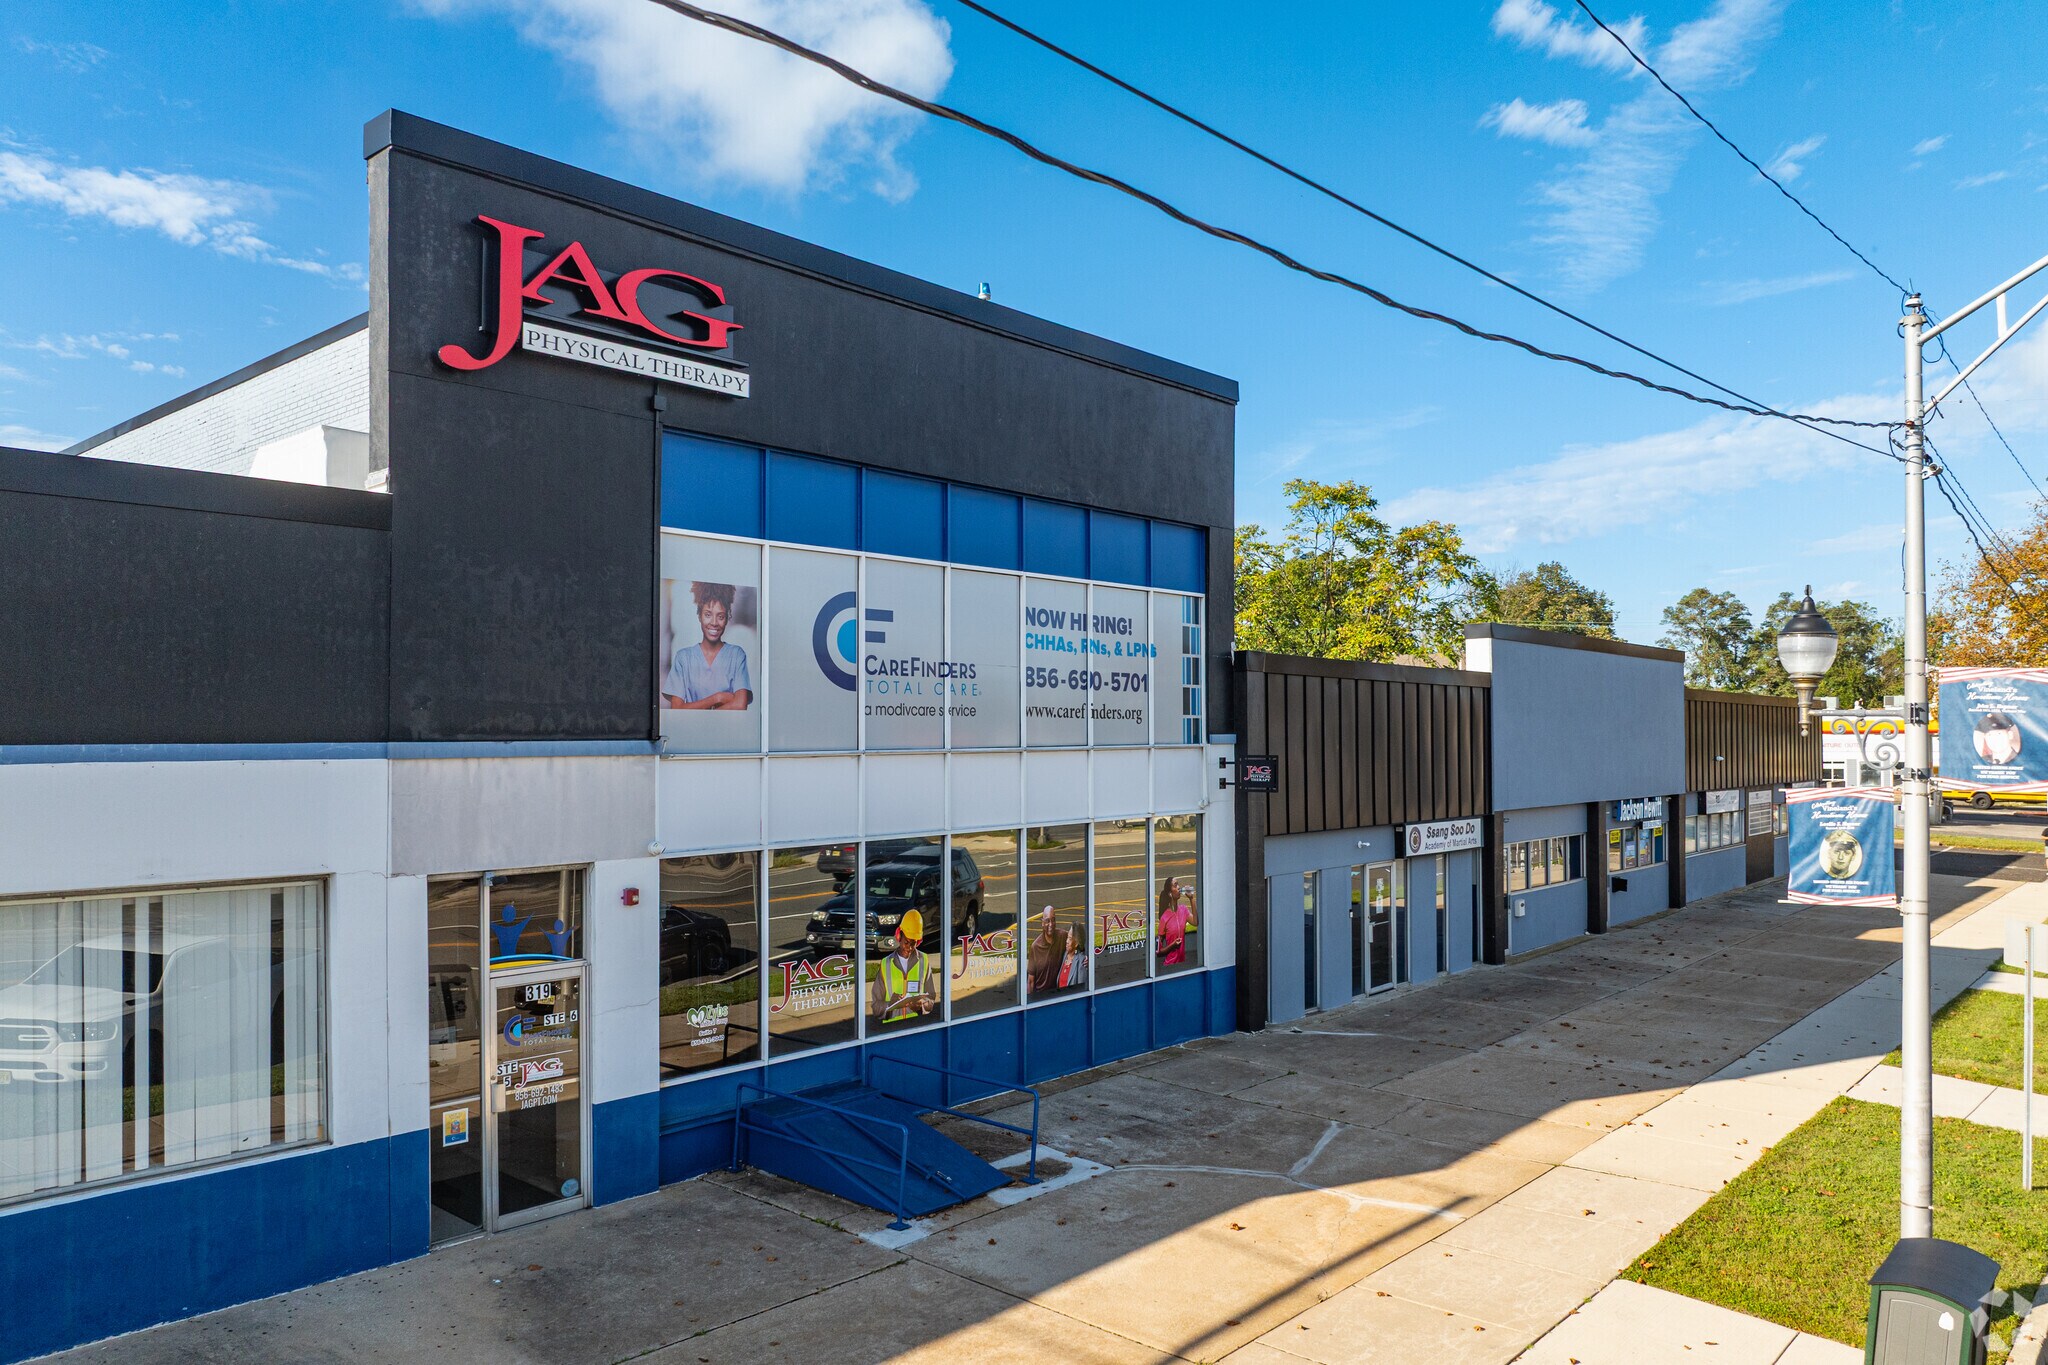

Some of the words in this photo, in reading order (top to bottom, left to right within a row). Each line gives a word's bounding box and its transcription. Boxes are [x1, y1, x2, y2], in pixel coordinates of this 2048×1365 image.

[438, 213, 745, 371] JAG
[525, 328, 645, 371] PHYSICAL
[647, 356, 748, 393] THERAPY
[1025, 606, 1066, 629] NOW
[1070, 612, 1133, 636] HIRING!
[1025, 632, 1077, 656] CHHAs,
[1081, 638, 1110, 658] RNs,
[1114, 641, 1122, 657] &
[1126, 642, 1157, 659] LPNs
[866, 680, 922, 695] TOTAL
[1025, 666, 1148, 693] 856-690-5701
[865, 706, 872, 717] a
[875, 702, 937, 717] modivcare
[1025, 702, 1143, 725] www.carefinders.org
[1243, 765, 1272, 781] JAG
[1620, 800, 1643, 821] Jackson
[1644, 796, 1662, 818] Hewitt
[1426, 826, 1449, 840] Ssang
[1450, 823, 1464, 836] Soo
[1465, 822, 1475, 834] Do
[1424, 841, 1446, 850] Academy
[1447, 840, 1452, 848] of
[1453, 838, 1468, 847] Martial
[1468, 836, 1477, 845] Arts
[1094, 910, 1146, 955] JAG
[1107, 931, 1147, 945] PHYSICAL
[951, 930, 1017, 980] JAG
[1107, 940, 1146, 954] THERAPY
[969, 953, 1016, 968] PHYSICAL
[970, 964, 1015, 979] THERAPY
[526, 983, 551, 1001] 319
[770, 954, 854, 1013] JAG
[791, 980, 853, 1000] PHYSICAL
[791, 991, 852, 1011] THERAPY
[545, 1012, 564, 1026] STE
[570, 1010, 577, 1021] 6
[524, 1038, 547, 1047] TOTAL
[497, 1061, 518, 1076] STE
[514, 1057, 564, 1090] JAG
[504, 1076, 511, 1087] 5
[515, 1083, 564, 1101] 856-692-1483
[520, 1094, 558, 1111] JAGPT.COM
